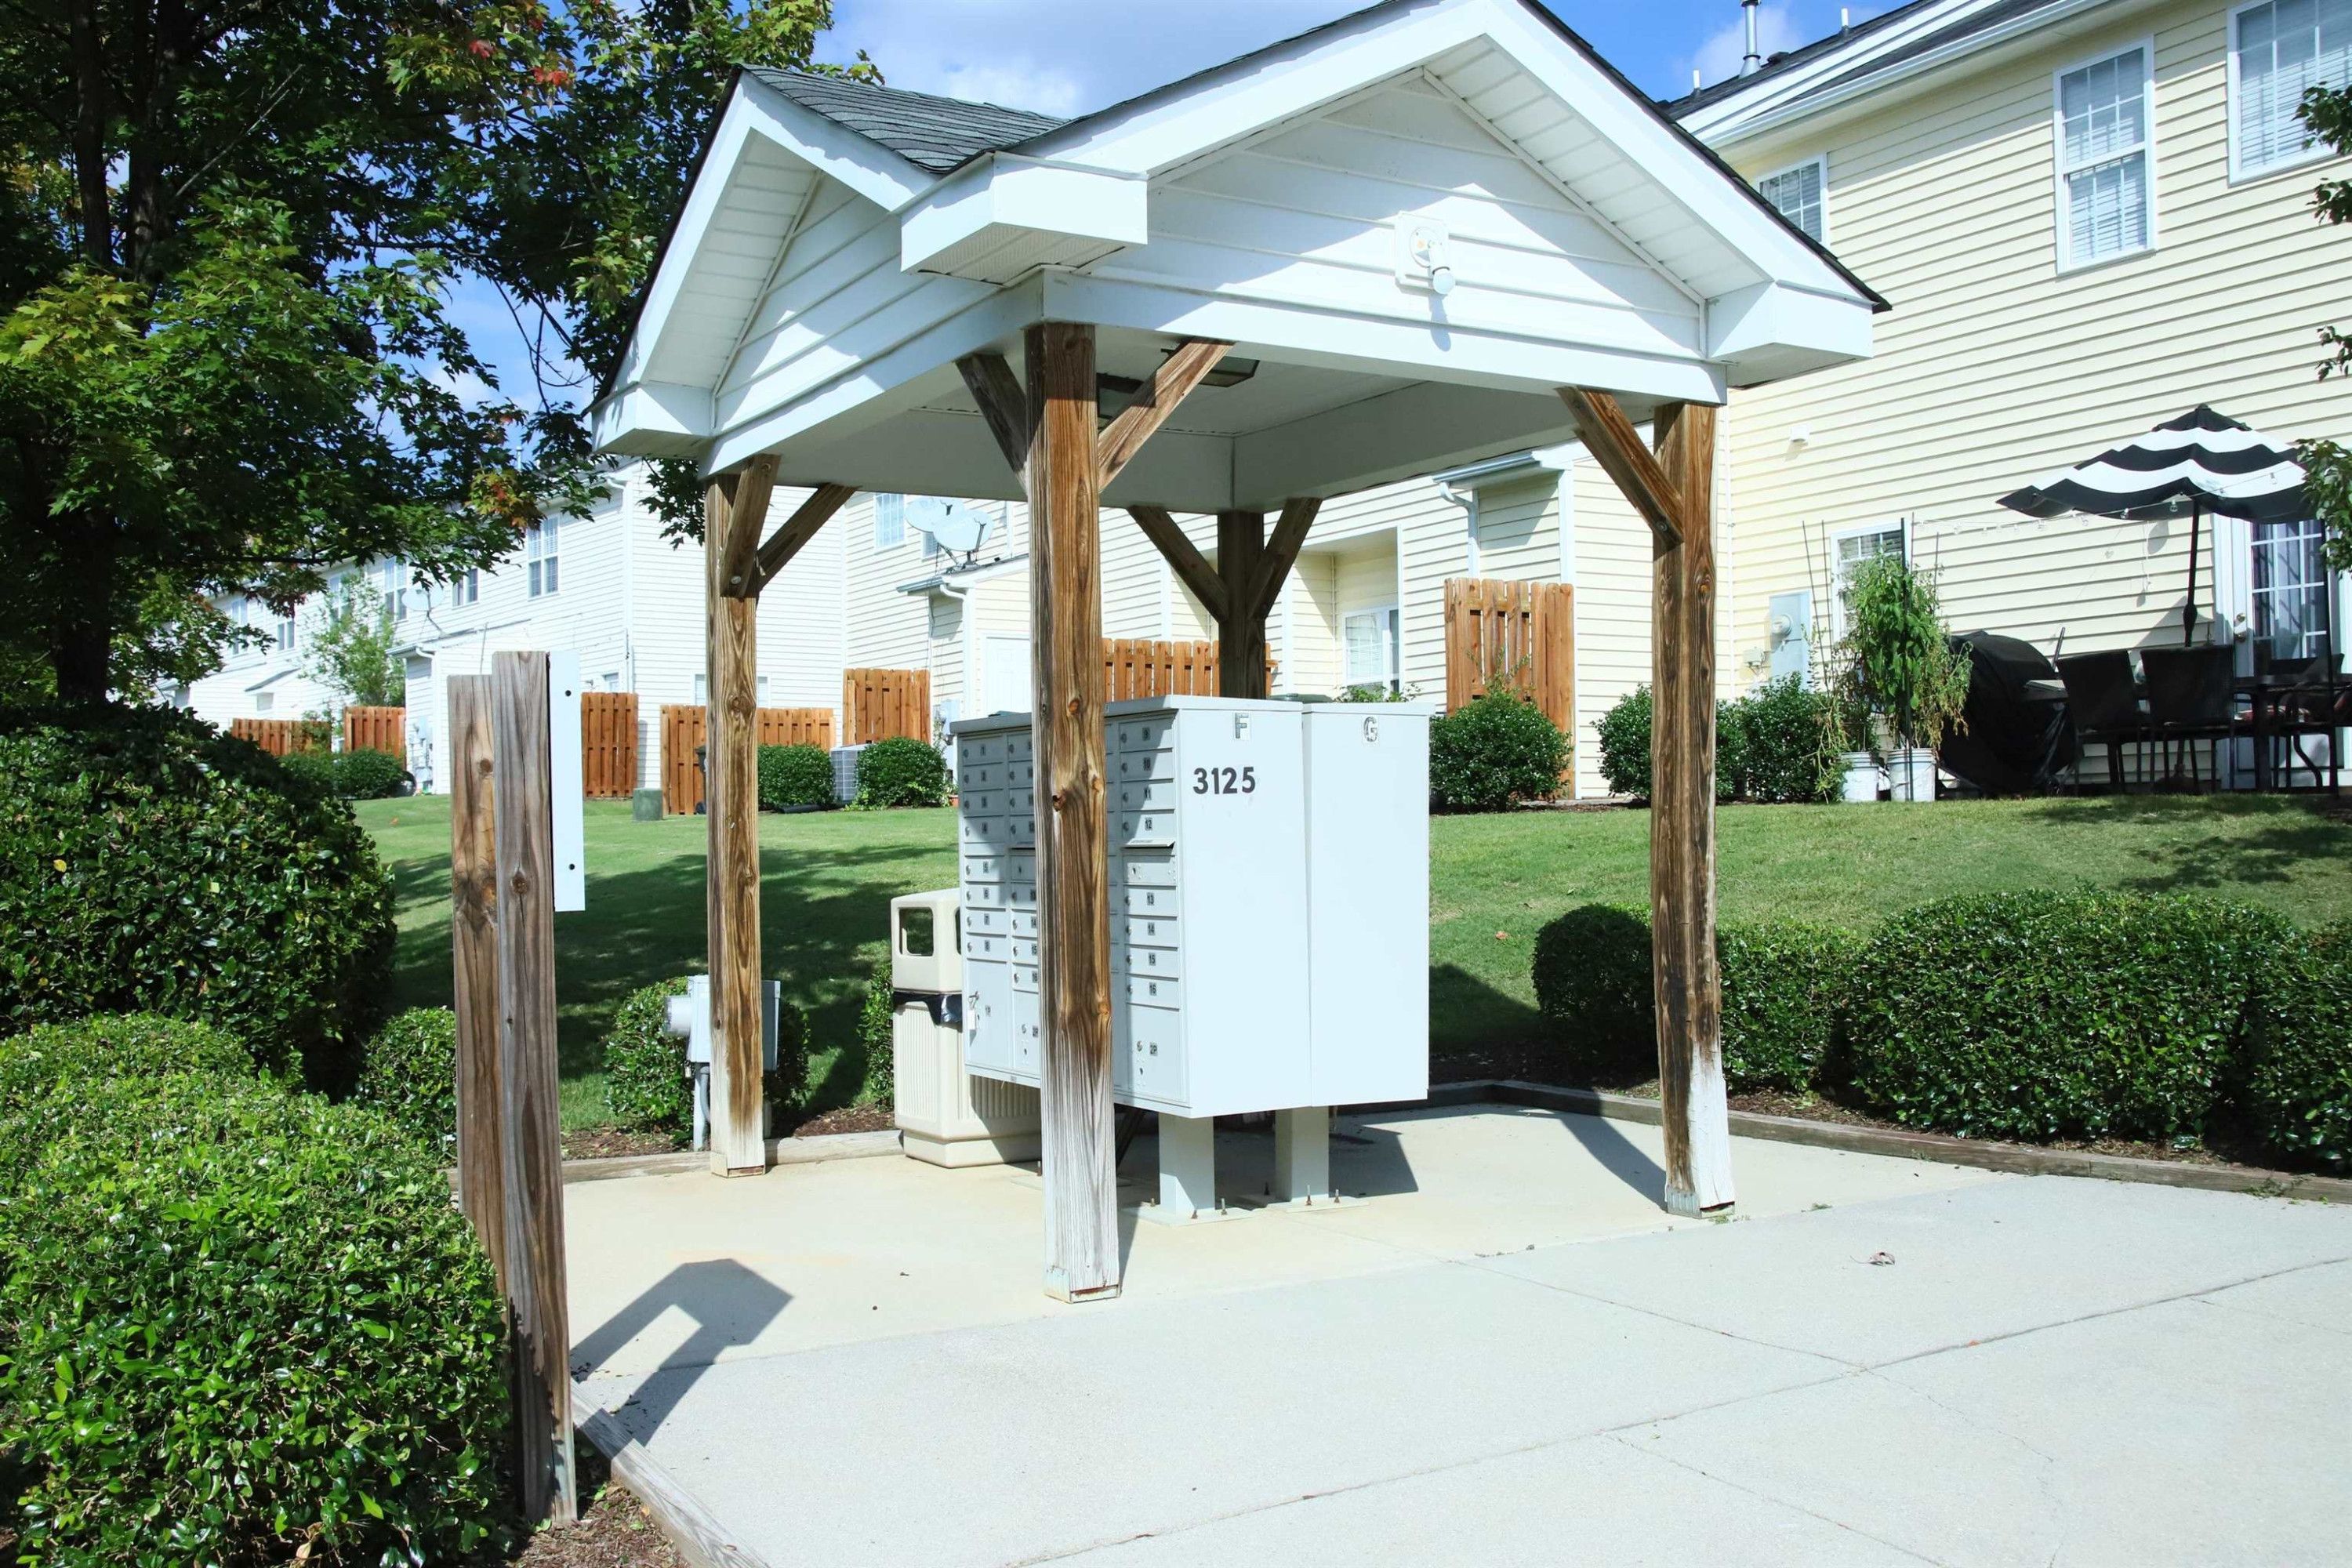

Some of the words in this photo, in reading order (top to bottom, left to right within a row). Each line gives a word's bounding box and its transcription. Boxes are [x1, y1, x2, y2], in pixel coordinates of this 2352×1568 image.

[1235, 713, 1250, 739] F
[1363, 717, 1378, 742] G
[1144, 759, 1150, 770] 10
[1192, 767, 1256, 794] 3125
[1145, 788, 1151, 799] 11
[1145, 818, 1152, 829] 12
[1147, 894, 1154, 904] 13
[1148, 924, 1155, 934] 14
[1149, 954, 1155, 964] 15
[1149, 984, 1156, 994] 16
[1150, 1044, 1157, 1054] 2P
